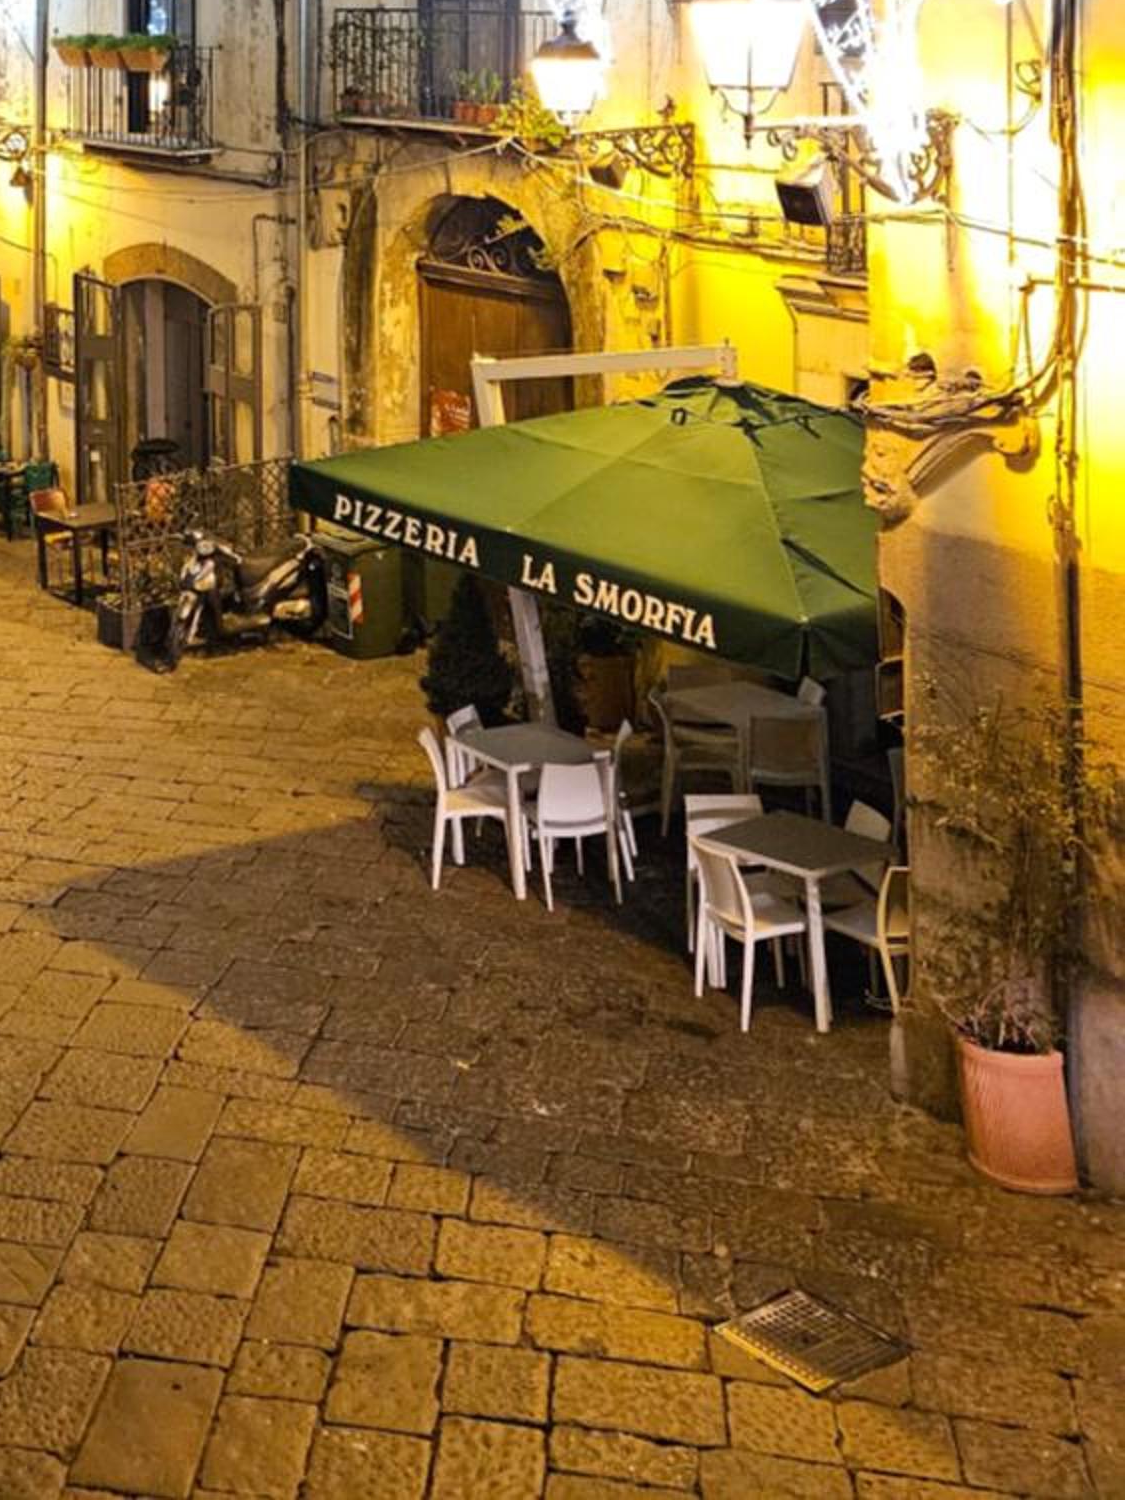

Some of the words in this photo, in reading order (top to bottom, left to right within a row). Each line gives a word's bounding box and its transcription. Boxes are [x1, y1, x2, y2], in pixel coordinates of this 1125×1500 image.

[333, 494, 480, 568] PIZZERIA
[521, 554, 557, 594] LA
[574, 573, 716, 649] SMORFIA
